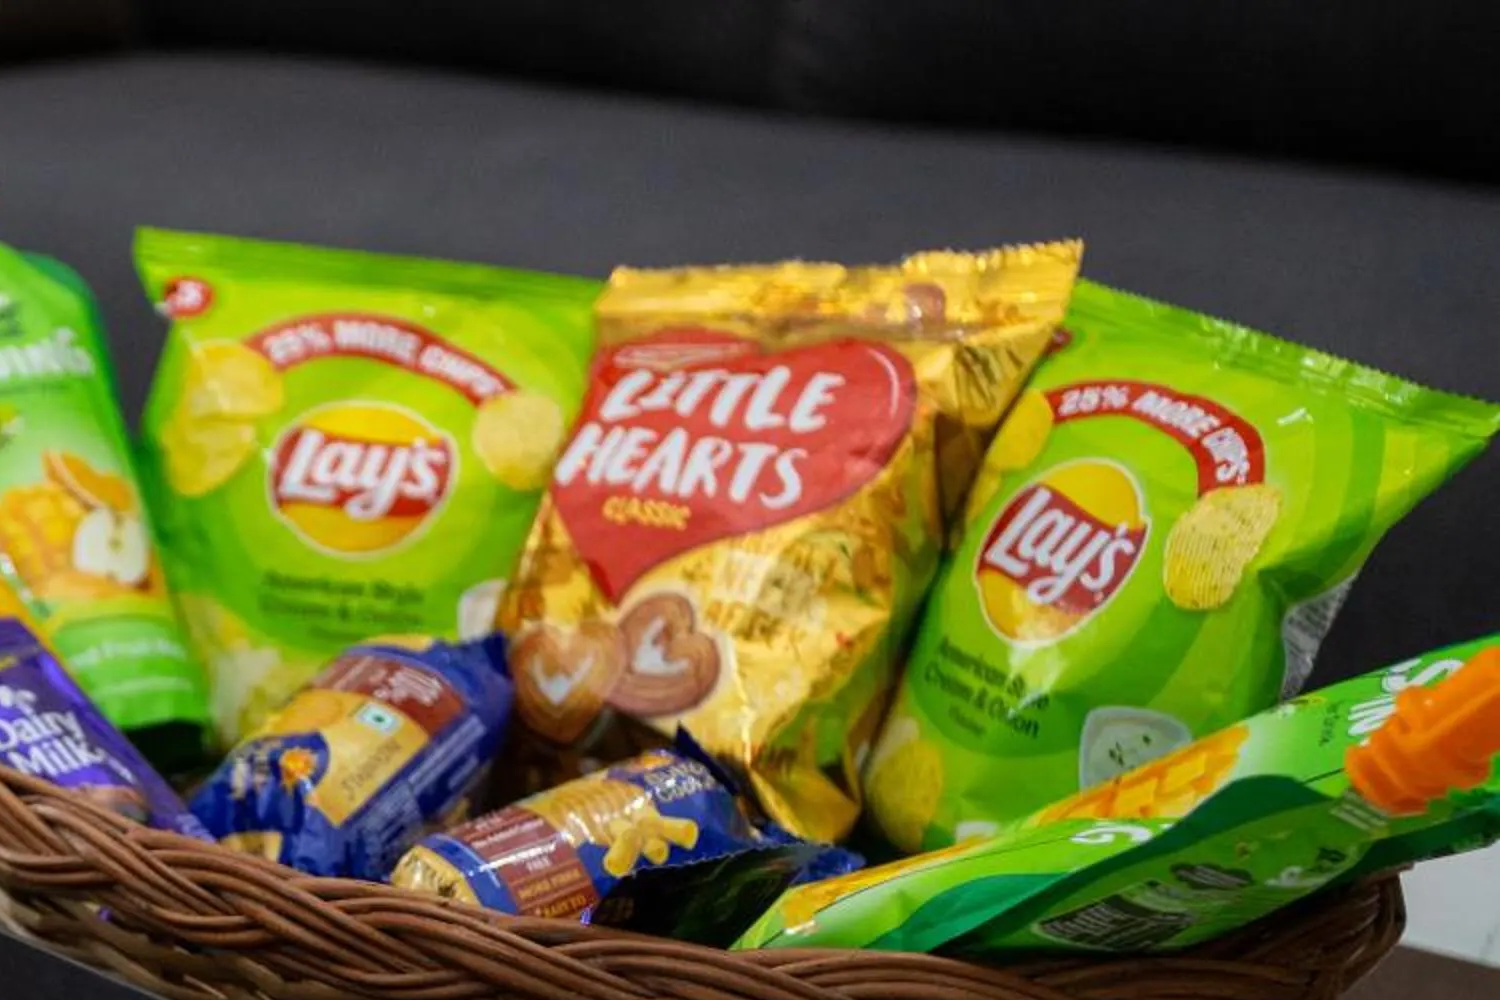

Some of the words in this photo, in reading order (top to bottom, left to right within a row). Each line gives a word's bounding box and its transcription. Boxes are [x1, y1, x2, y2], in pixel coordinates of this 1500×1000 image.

[601, 365, 845, 433] LITTLE
[1132, 390, 1221, 438] MORE
[278, 428, 446, 520] Lay's
[555, 422, 809, 510] HEARTS
[985, 486, 1136, 604] Lay's
[7, 735, 105, 778] Milk
